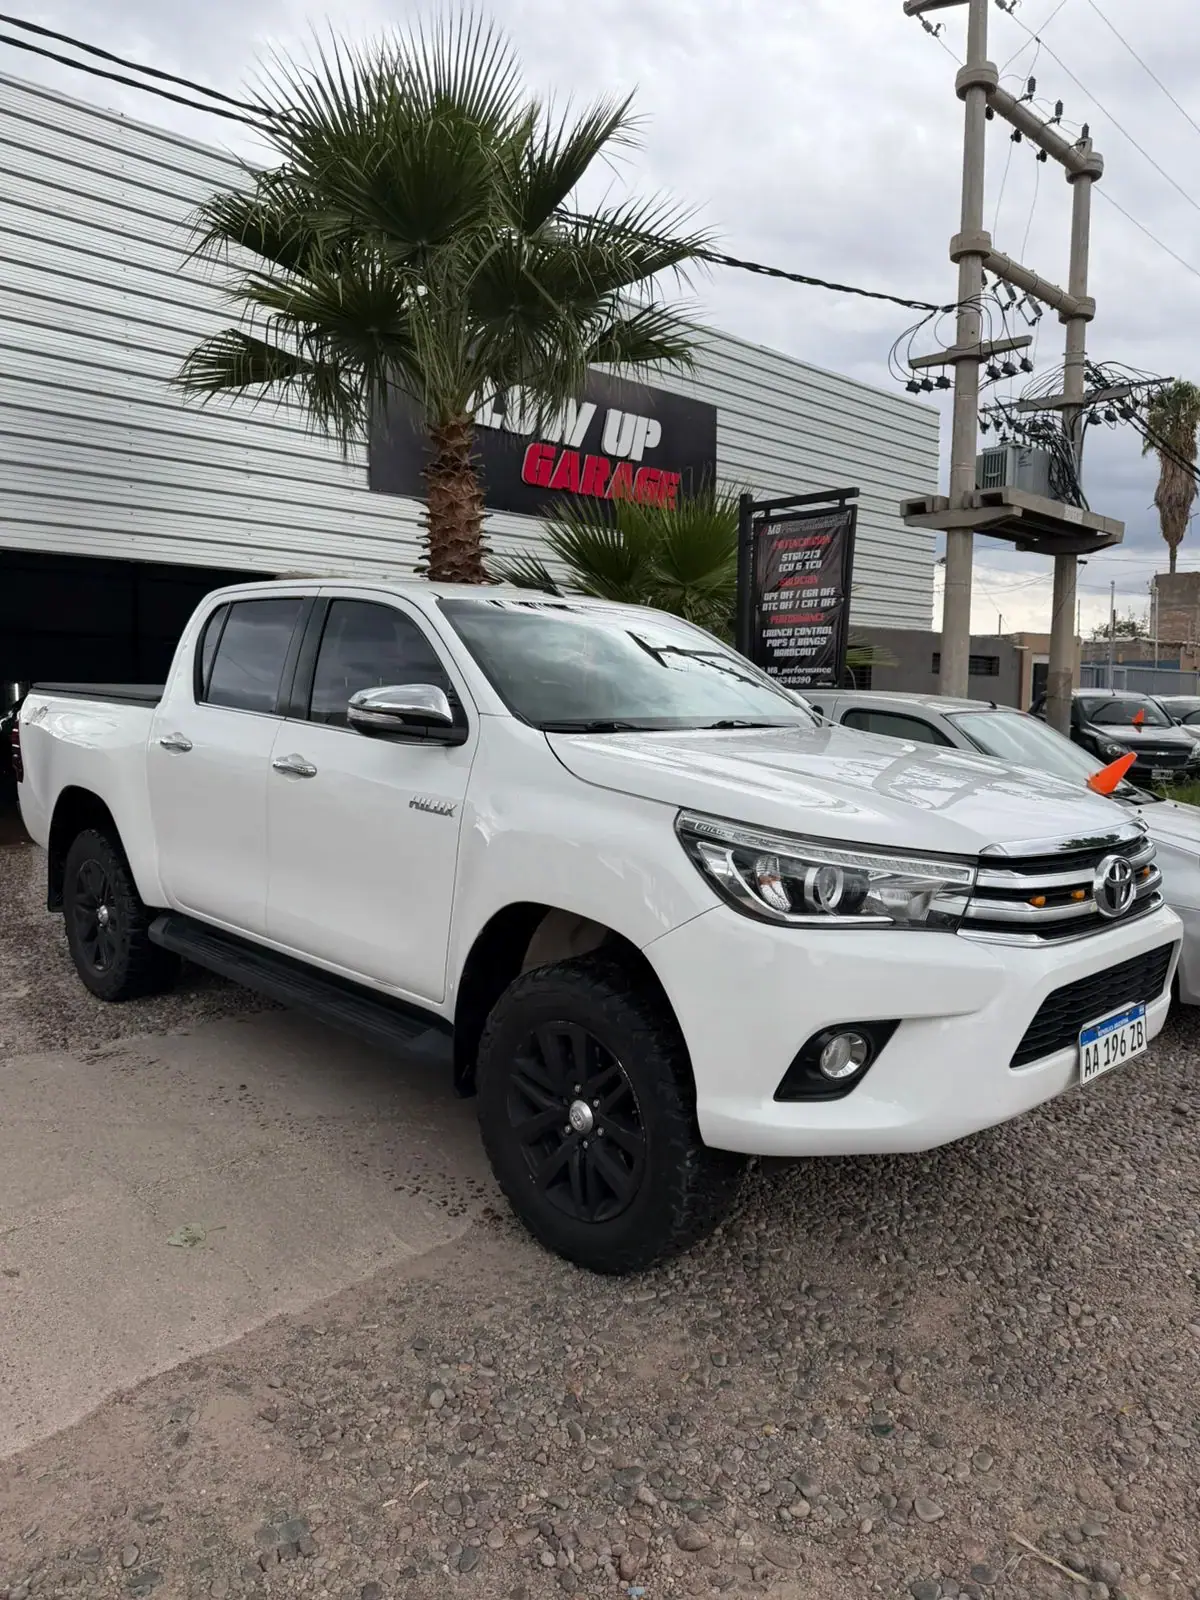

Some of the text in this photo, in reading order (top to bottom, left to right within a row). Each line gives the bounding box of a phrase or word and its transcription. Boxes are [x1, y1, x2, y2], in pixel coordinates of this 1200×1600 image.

[601, 408, 662, 462] UP
[521, 442, 681, 511] GARAGE
[779, 563, 794, 572] ECU
[805, 560, 822, 570] TCU
[781, 590, 794, 600] OFF
[802, 588, 818, 598] EGR
[820, 587, 836, 597] OFF
[762, 602, 778, 612] DTC
[780, 601, 793, 610] OFF
[801, 599, 818, 608] CAT
[820, 597, 837, 606] OFF
[762, 626, 832, 638] LAUNCH CONTROL
[767, 638, 788, 647] POPS
[797, 636, 827, 646] BANGS
[409, 795, 458, 817] HILUX
[1085, 1043, 1100, 1078] AA
[1103, 1029, 1127, 1067] 196
[1129, 1020, 1144, 1052] ZB
